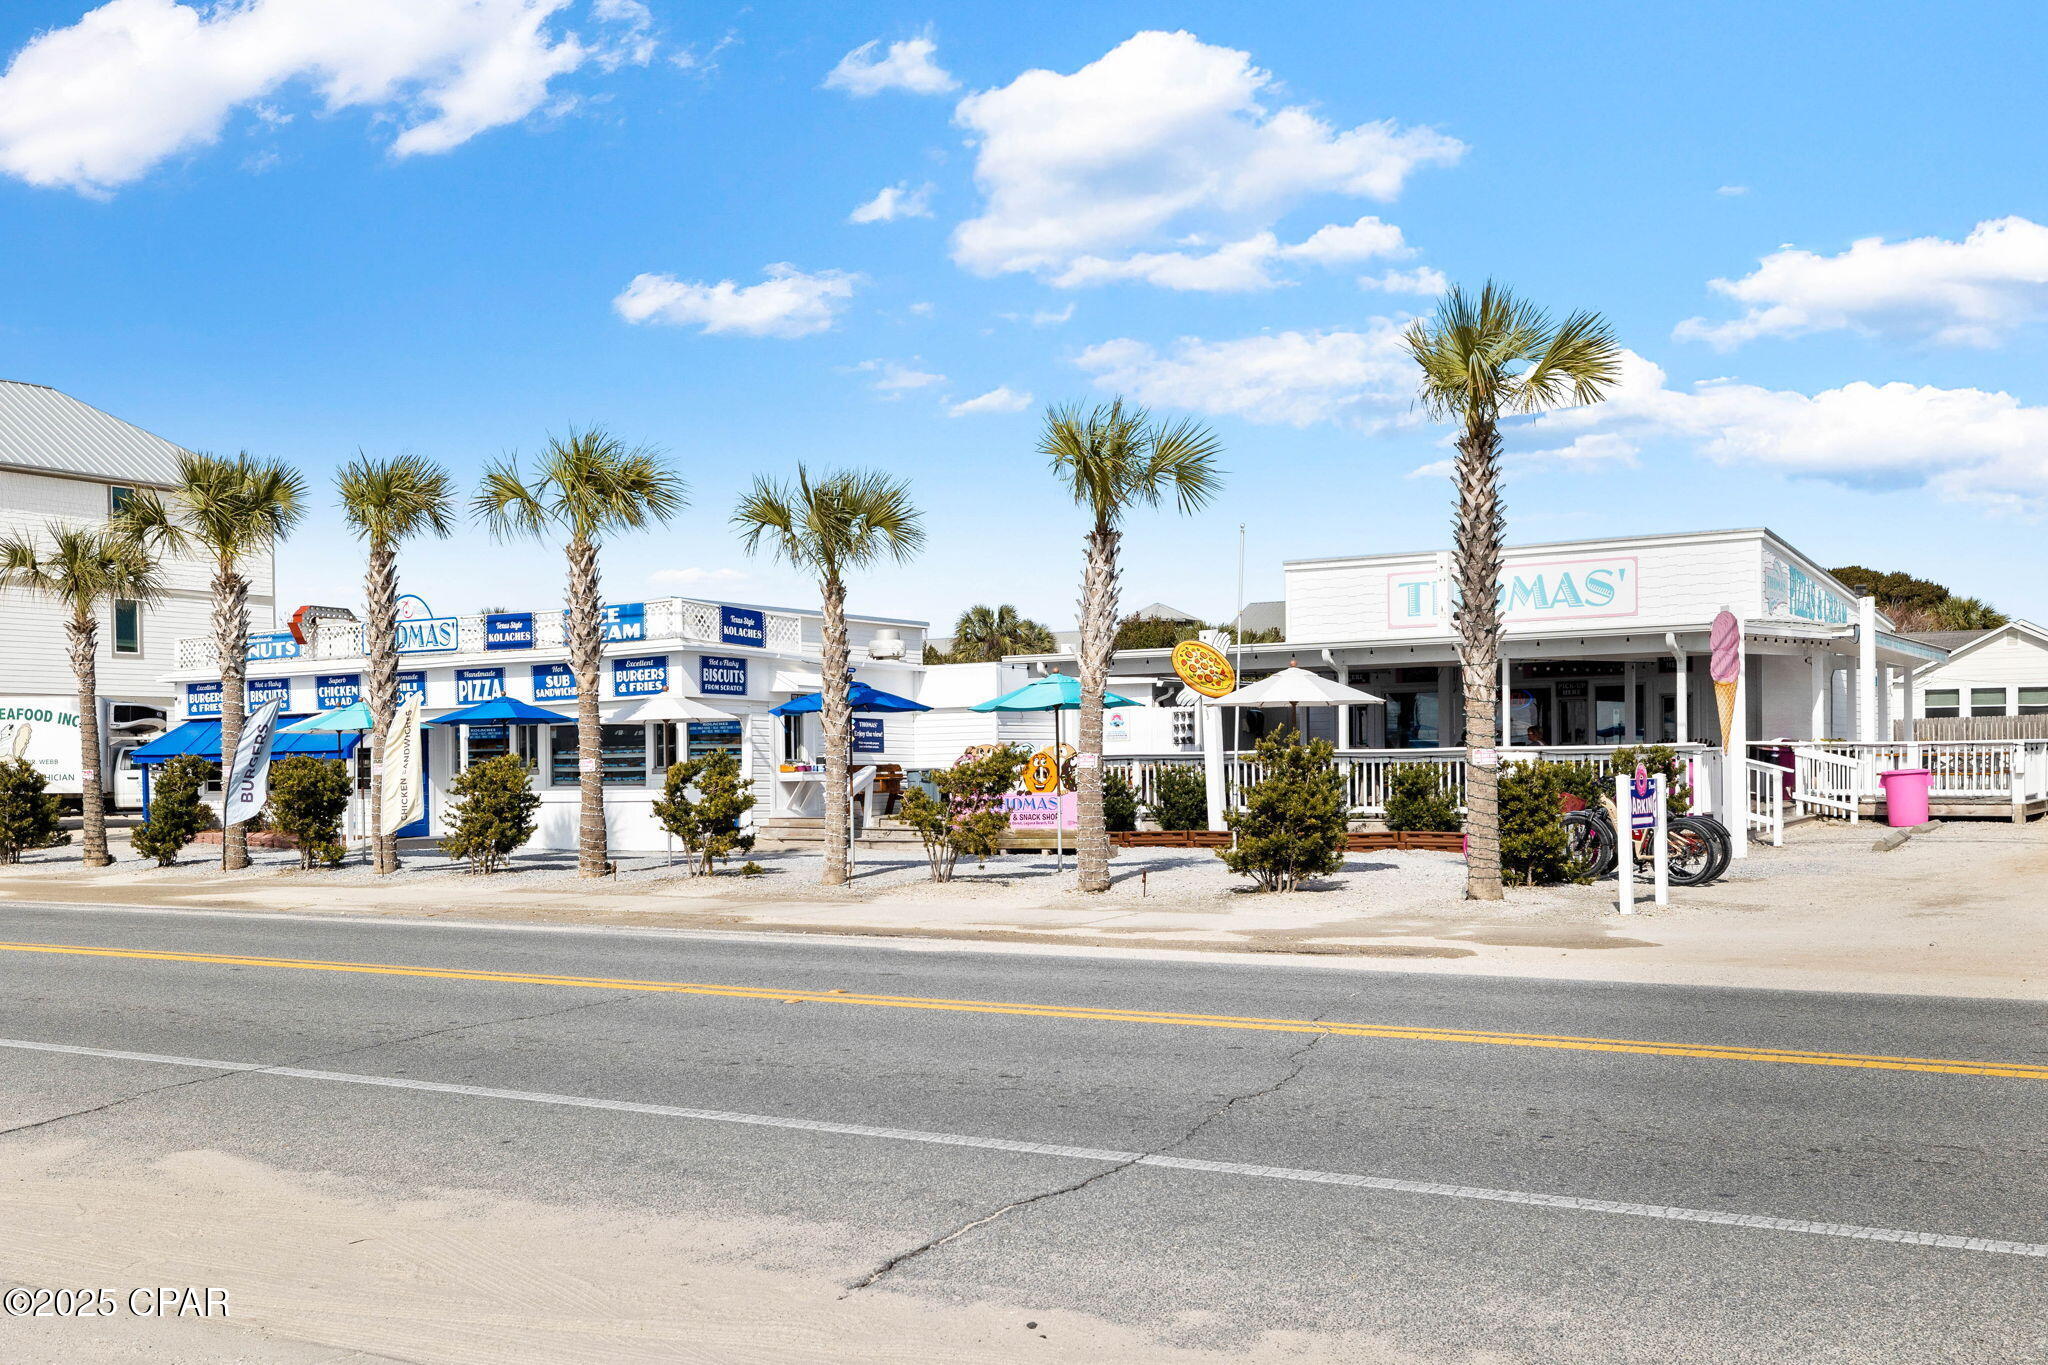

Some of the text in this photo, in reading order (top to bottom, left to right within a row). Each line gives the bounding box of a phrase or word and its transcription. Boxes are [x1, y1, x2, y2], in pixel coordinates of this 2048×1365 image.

[1399, 568, 1627, 617] TMAS'
[597, 607, 621, 624] CE
[395, 622, 455, 649] OMAS'
[488, 631, 531, 642] KOLACHES
[598, 623, 641, 641] EAM
[723, 625, 762, 639] KOLACHES
[247, 640, 296, 659] NUTS
[626, 660, 654, 668] Excellent
[545, 675, 570, 688] SUB
[615, 668, 665, 682] BURGERS
[703, 668, 745, 683] BISCUITS
[318, 685, 359, 698] CHICKEN
[458, 679, 502, 701] PIZZA
[535, 686, 578, 698] SANDWICHE
[618, 681, 663, 692] & FRIES
[250, 689, 288, 703] BISCUITS
[324, 697, 352, 706] SALAD
[0, 707, 53, 723] EAFOOD
[191, 704, 198, 713] &
[240, 724, 268, 803] BURGERS
[44, 773, 75, 781] HICIAN
[400, 778, 408, 821] CHICKEN
[998, 797, 1058, 811] HOMAS
[1632, 791, 1657, 818] ARKING
[1020, 813, 1040, 821] SNACK
